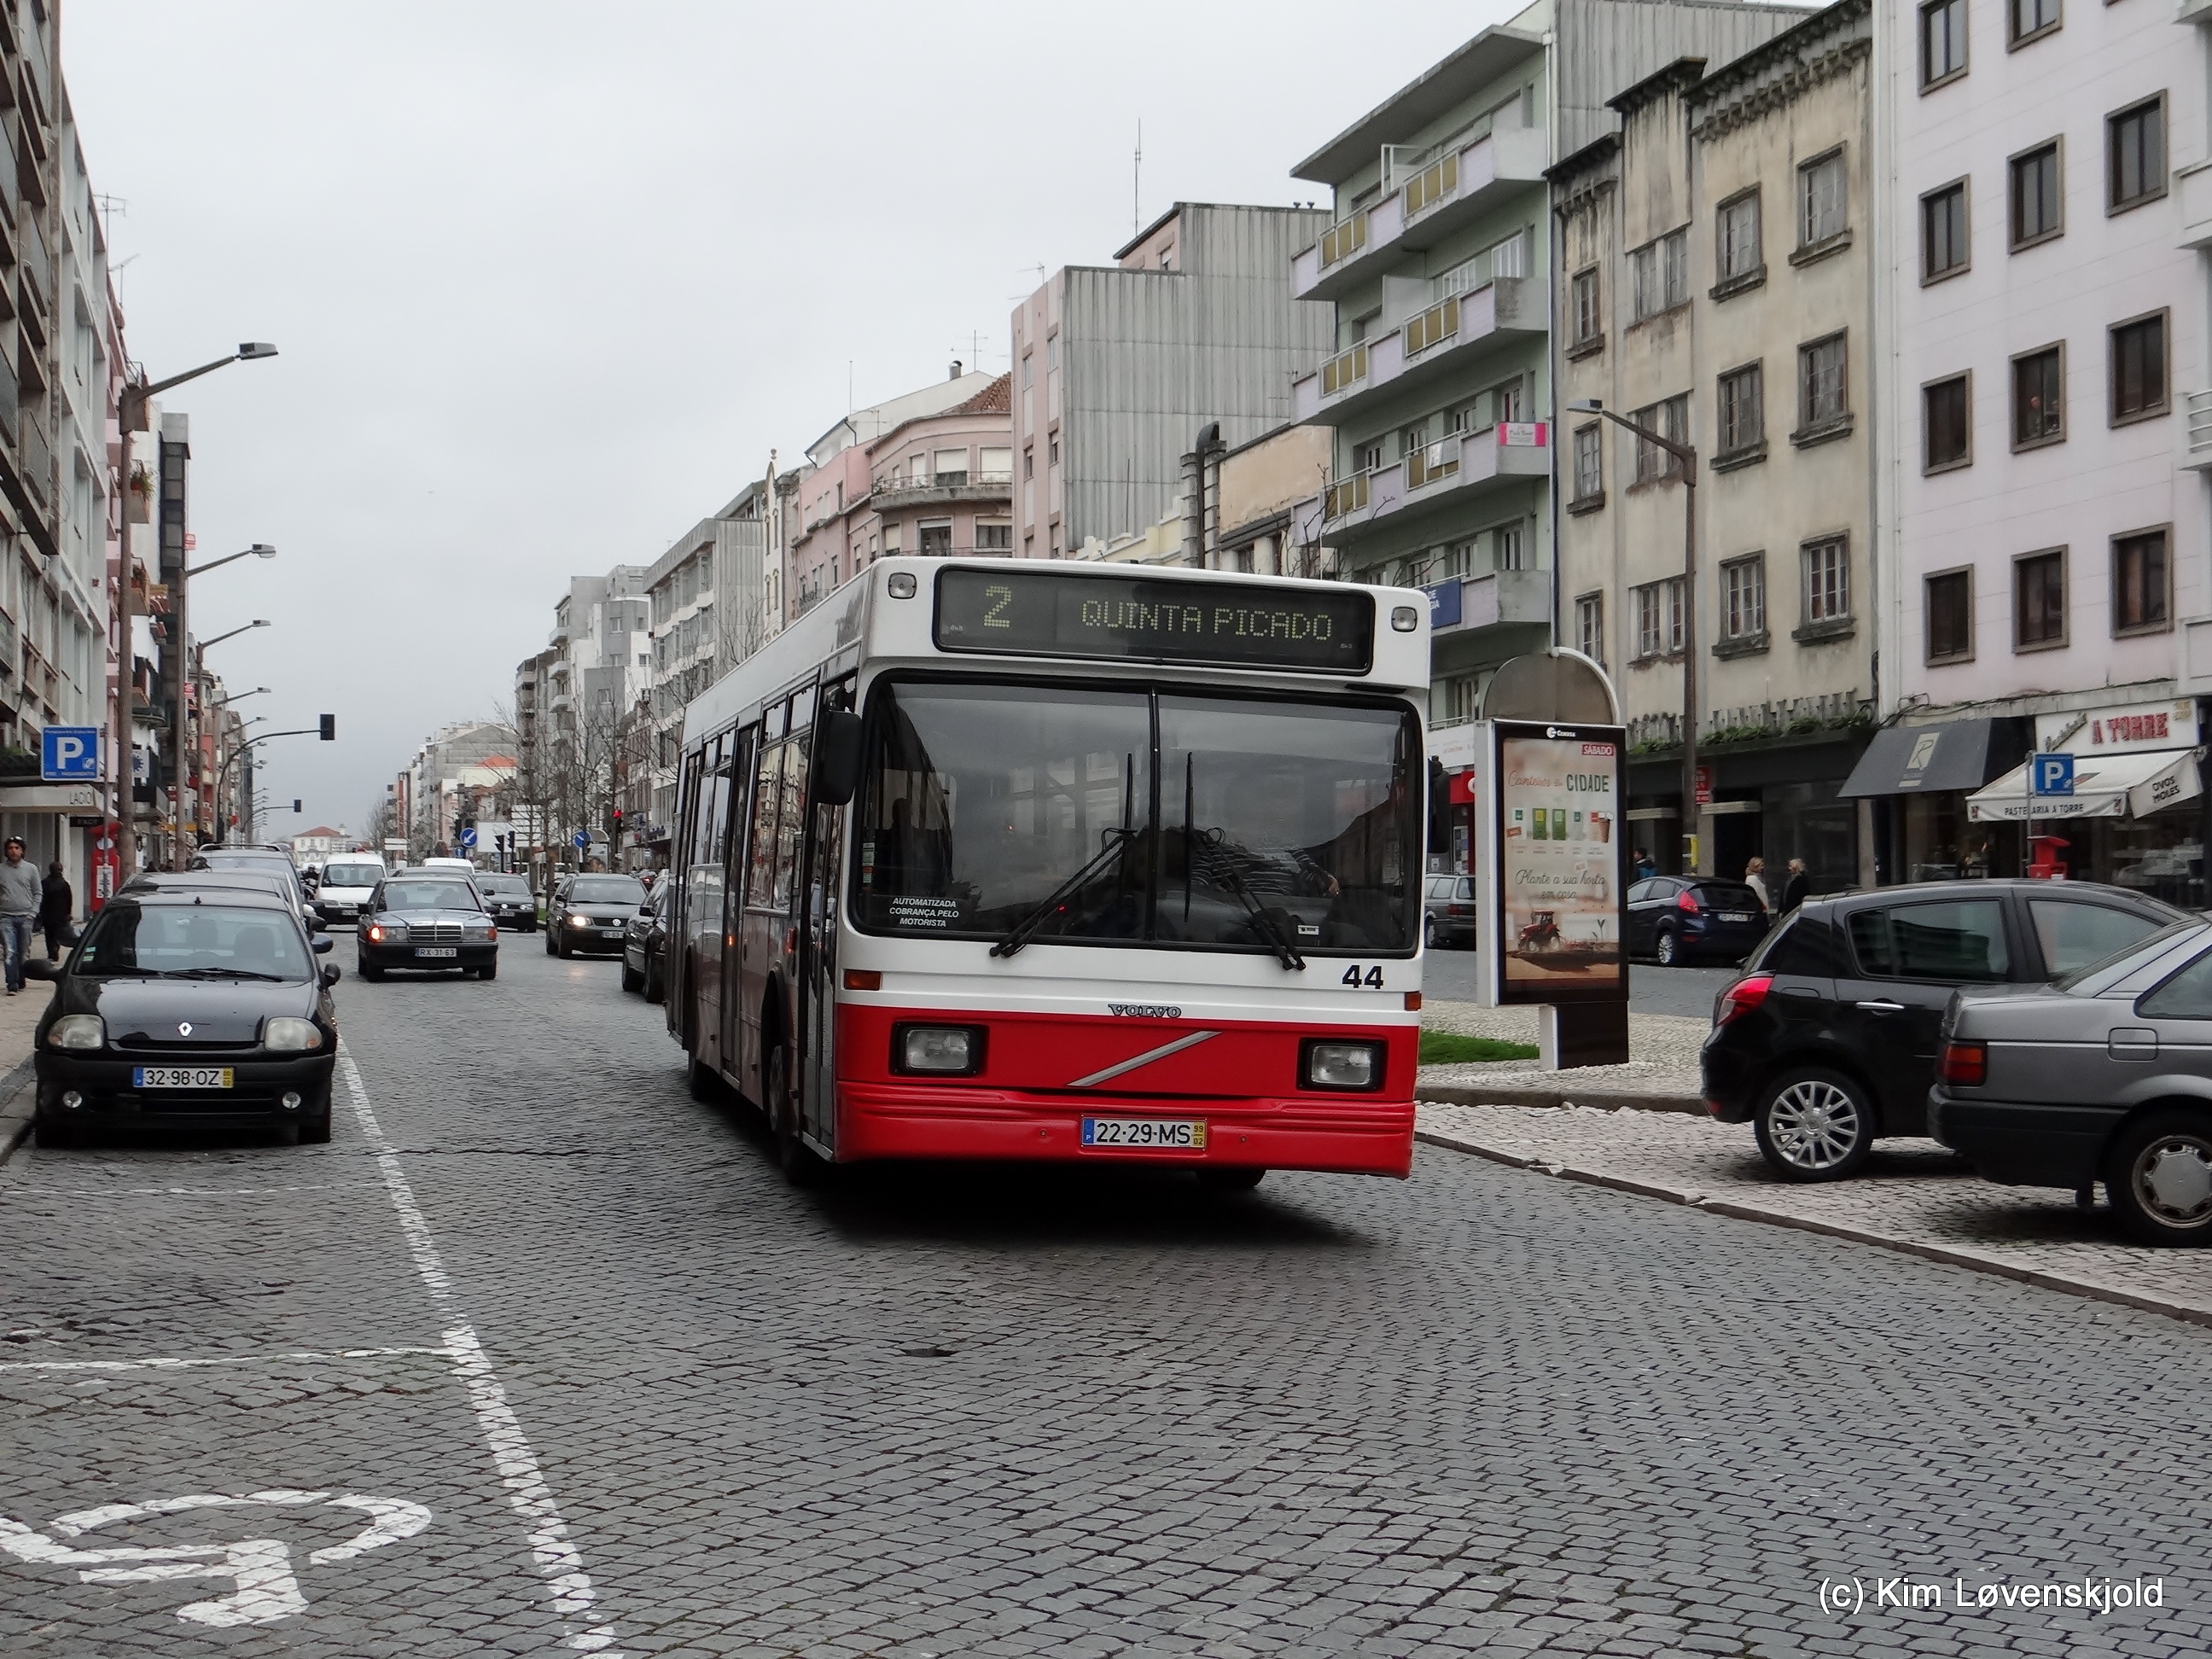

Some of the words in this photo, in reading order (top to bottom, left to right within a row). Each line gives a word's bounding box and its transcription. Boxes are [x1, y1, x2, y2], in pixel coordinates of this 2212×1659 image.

[983, 585, 1011, 628] 2
[1081, 600, 1202, 633] QUINTA
[1214, 608, 1331, 641] PICADO
[2107, 713, 2168, 742] TORRE
[56, 736, 84, 769] P
[1566, 773, 1610, 793] CIDADE
[2045, 761, 2064, 789] P
[2151, 775, 2176, 791] OVOS
[2151, 785, 2180, 803] MOLES
[2005, 806, 2049, 816] PASTEARIA
[2058, 804, 2084, 813] TORRE
[1515, 869, 1551, 884] Plante
[1580, 870, 1606, 885] horta
[893, 898, 957, 908] AUTOMATIZADA
[889, 907, 936, 918] COBRANÇA
[937, 910, 959, 918] PELO
[899, 917, 946, 928] MOTORISTA
[1342, 964, 1384, 990] 44
[1108, 1004, 1181, 1018] VOLVO
